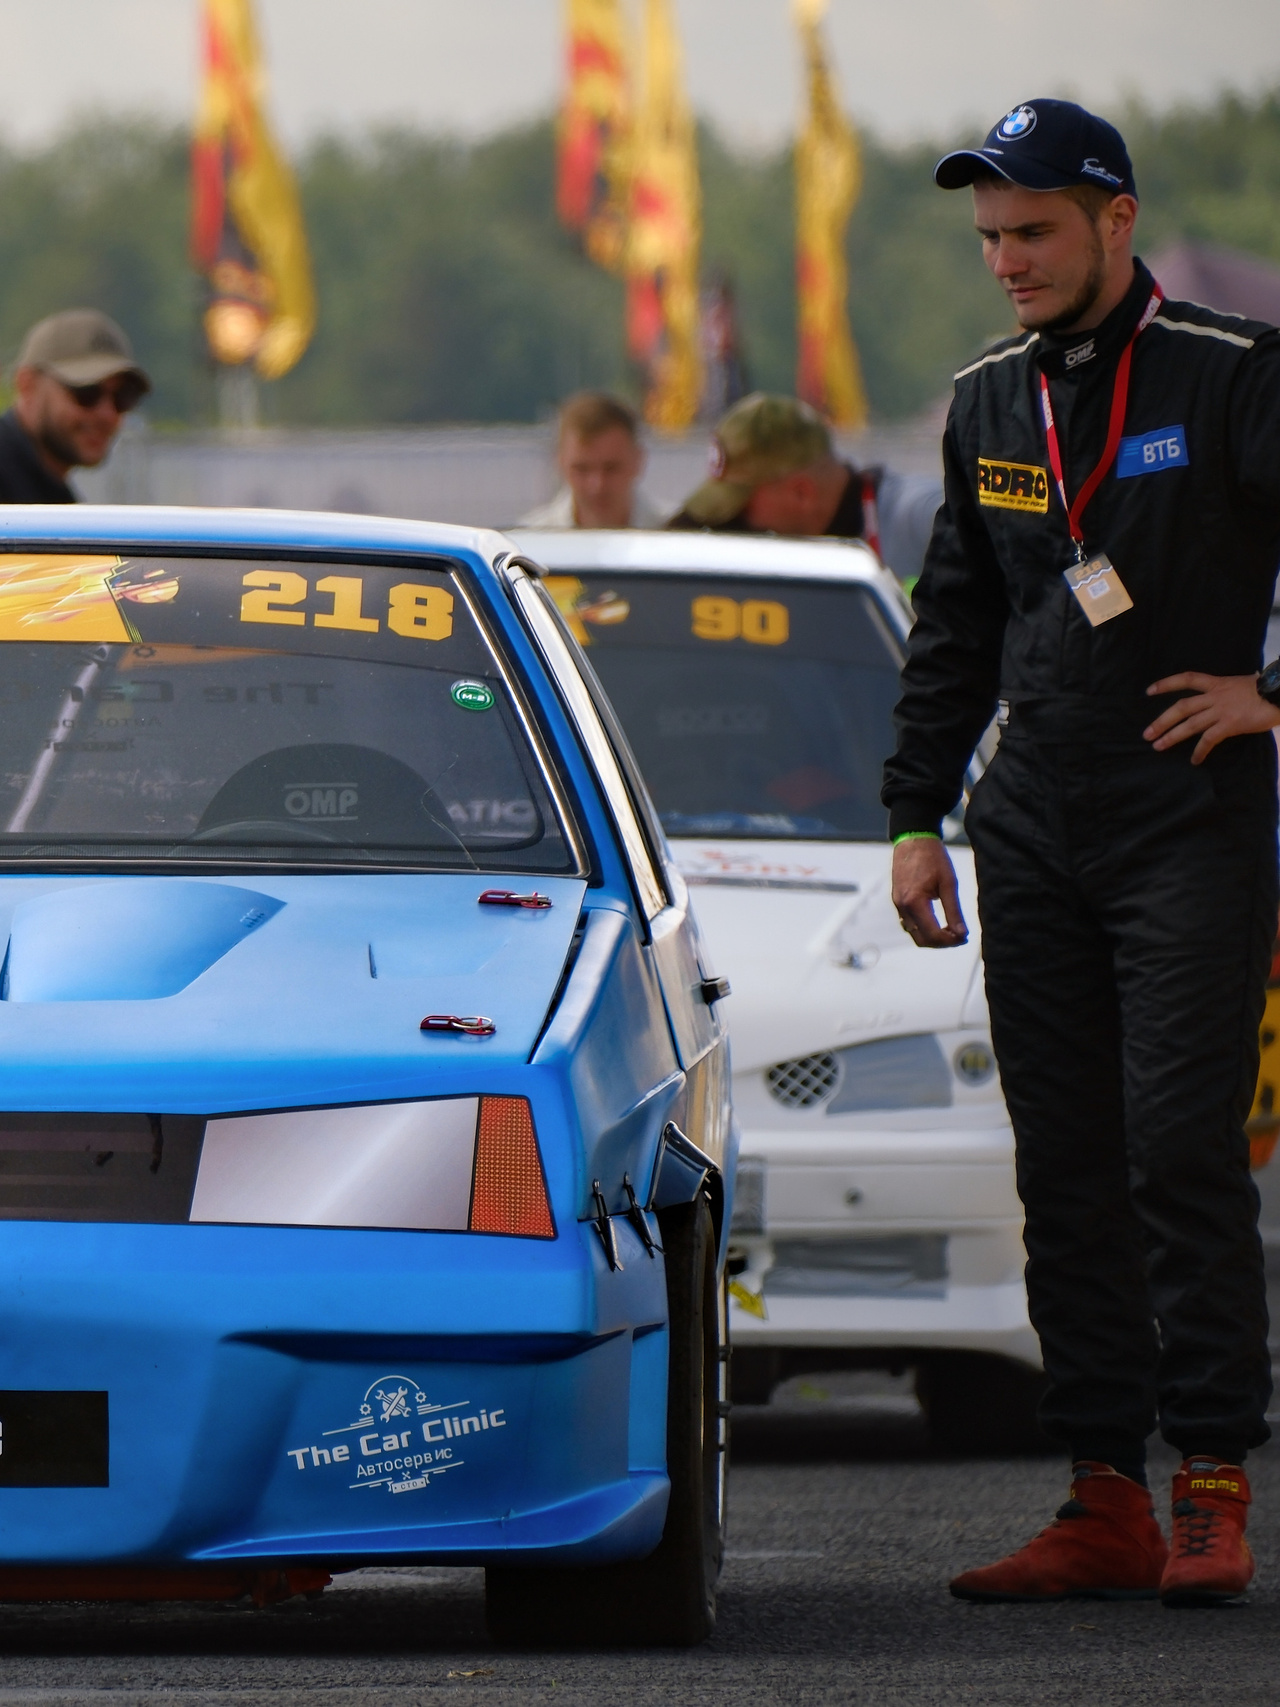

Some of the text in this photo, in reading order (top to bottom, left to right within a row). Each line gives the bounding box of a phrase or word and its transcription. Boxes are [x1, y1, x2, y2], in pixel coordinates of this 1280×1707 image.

[1065, 341, 1095, 366] OMP
[1143, 436, 1181, 464] ВТБ
[978, 465, 1047, 500] RDRC
[240, 570, 454, 641] 218
[692, 594, 789, 645] 90
[284, 788, 359, 816] OMP
[287, 1408, 507, 1470] The Car Clinic
[356, 1446, 453, 1479] Автосервис
